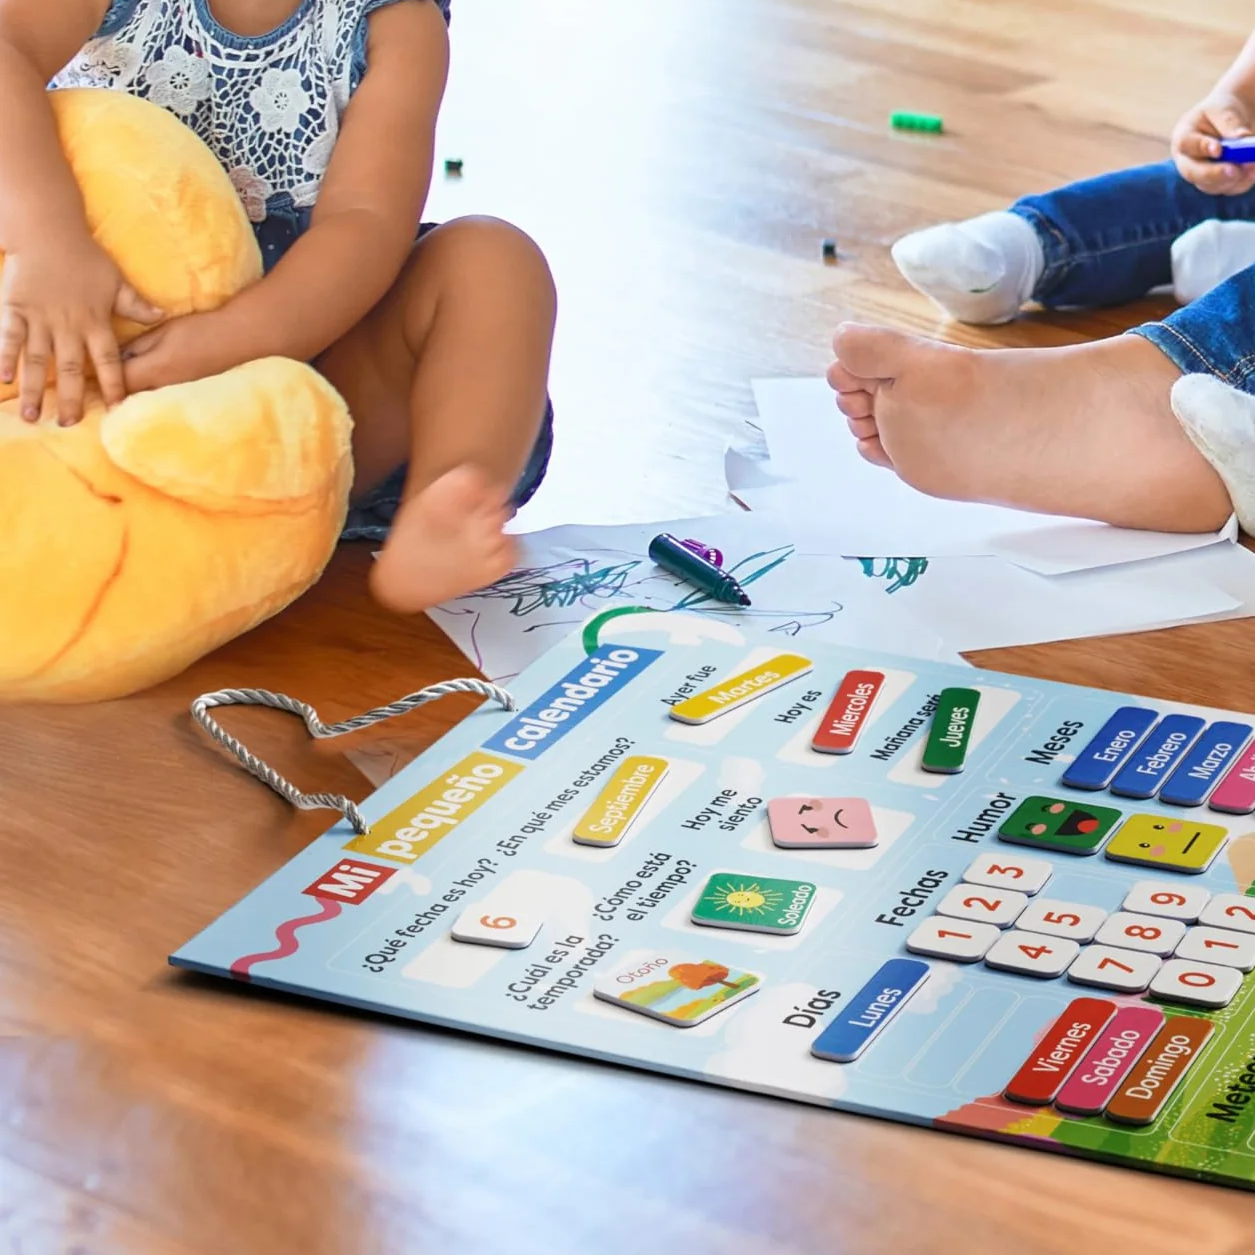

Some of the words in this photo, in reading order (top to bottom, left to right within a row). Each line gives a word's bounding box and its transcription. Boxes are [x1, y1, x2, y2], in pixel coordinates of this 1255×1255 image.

[660, 683, 696, 706] Ayer
[686, 665, 717, 683] fue
[708, 669, 781, 705] Martes
[774, 704, 804, 725] Hoy
[801, 689, 823, 705] es
[829, 683, 875, 736] Miercoles
[939, 707, 970, 747] Jueves
[870, 717, 924, 761] Mañana
[1024, 720, 1084, 765] Meses
[1093, 729, 1136, 762] Enero
[1137, 733, 1187, 775] Febrero
[317, 864, 383, 899] Mi
[375, 763, 504, 859] pequeño
[504, 649, 640, 751] calendario
[1189, 743, 1232, 780] Marzo
[496, 829, 526, 857] ¿En
[525, 807, 553, 835] qué
[546, 788, 579, 813] mes
[573, 737, 636, 789] estamos?
[588, 763, 656, 834] Septiembre
[681, 804, 715, 831] Hoy
[710, 789, 737, 810] me
[720, 796, 763, 832] siento
[951, 792, 1017, 843] Humor
[592, 879, 640, 922] ¿Cómo
[639, 852, 672, 880] está
[627, 904, 648, 922] el
[646, 859, 698, 910] tiempo?
[986, 864, 1024, 879] 3
[362, 934, 407, 973] ¿Qué
[397, 901, 449, 937] fecha
[443, 885, 466, 903] es
[460, 858, 500, 888] hoy?
[778, 885, 812, 926] Soleado
[875, 869, 949, 927] Fechas
[963, 896, 1002, 912] 2
[1150, 892, 1186, 907] 9
[479, 915, 517, 930] 6
[937, 929, 972, 940] 1
[1043, 911, 1081, 927] 5
[1124, 925, 1161, 940] 8
[1018, 944, 1053, 959] 4
[1204, 939, 1239, 950] 1
[507, 963, 555, 1002] ¿Cuál
[551, 948, 569, 965] es
[562, 935, 584, 950] la
[528, 933, 620, 1011] temporada?
[616, 956, 669, 985] Otoño
[1098, 957, 1134, 974] 7
[1178, 972, 1215, 987] 0
[783, 989, 842, 1029] Días
[848, 987, 902, 1028] Lunes
[1032, 1021, 1091, 1073] Viernes
[1081, 1030, 1140, 1086] Sabado
[1125, 1034, 1192, 1100] Domingo
